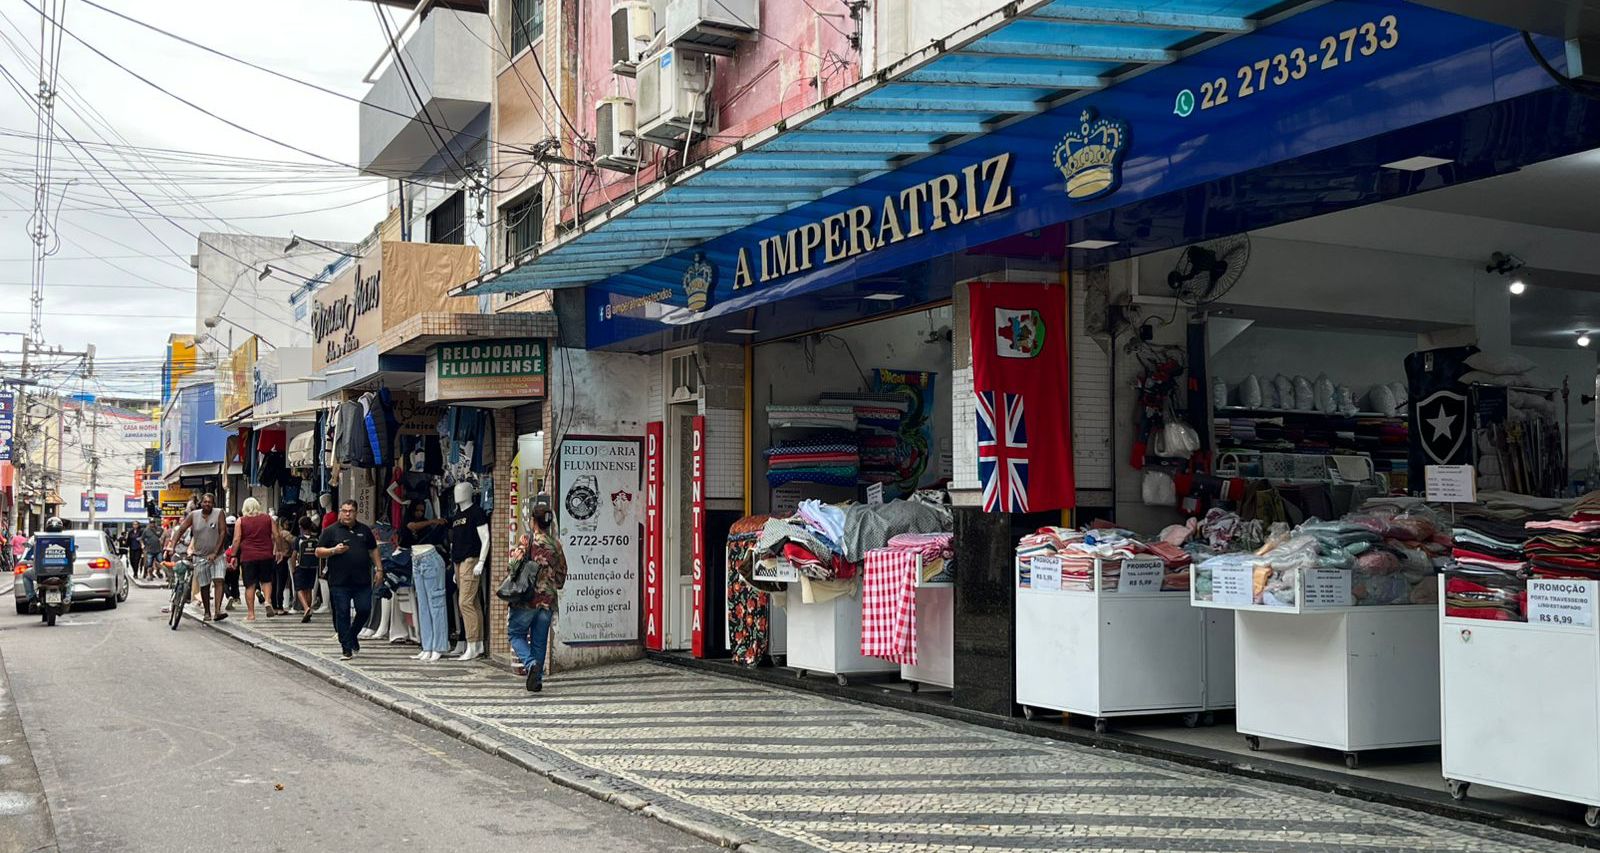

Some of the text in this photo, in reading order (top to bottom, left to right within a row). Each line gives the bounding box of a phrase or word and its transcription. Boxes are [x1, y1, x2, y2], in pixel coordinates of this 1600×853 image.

[1200, 15, 1399, 109] 22 2733-2733
[732, 152, 1012, 290] A IMPERATRIZ
[442, 343, 541, 361] RELOJOARIA
[442, 359, 541, 376] FLUMINENSE
[564, 460, 637, 472] FLUMINENSE
[648, 433, 656, 636] DENTISTA
[692, 430, 702, 632] DENTISTA
[569, 535, 630, 546] 2722-5760
[580, 555, 618, 566] Venda e
[1127, 562, 1162, 570] PROMOÇÃO
[623, 570, 635, 581] de
[576, 586, 622, 599] relógios e
[1533, 583, 1586, 594] PROMOÇÃO
[1550, 596, 1588, 604] TRAVESSEIRO
[565, 601, 631, 614] jóias em geral
[1540, 613, 1572, 624] R$ 6,99
[585, 621, 613, 632] Direção
[573, 632, 626, 640] Wilson Barbosa
